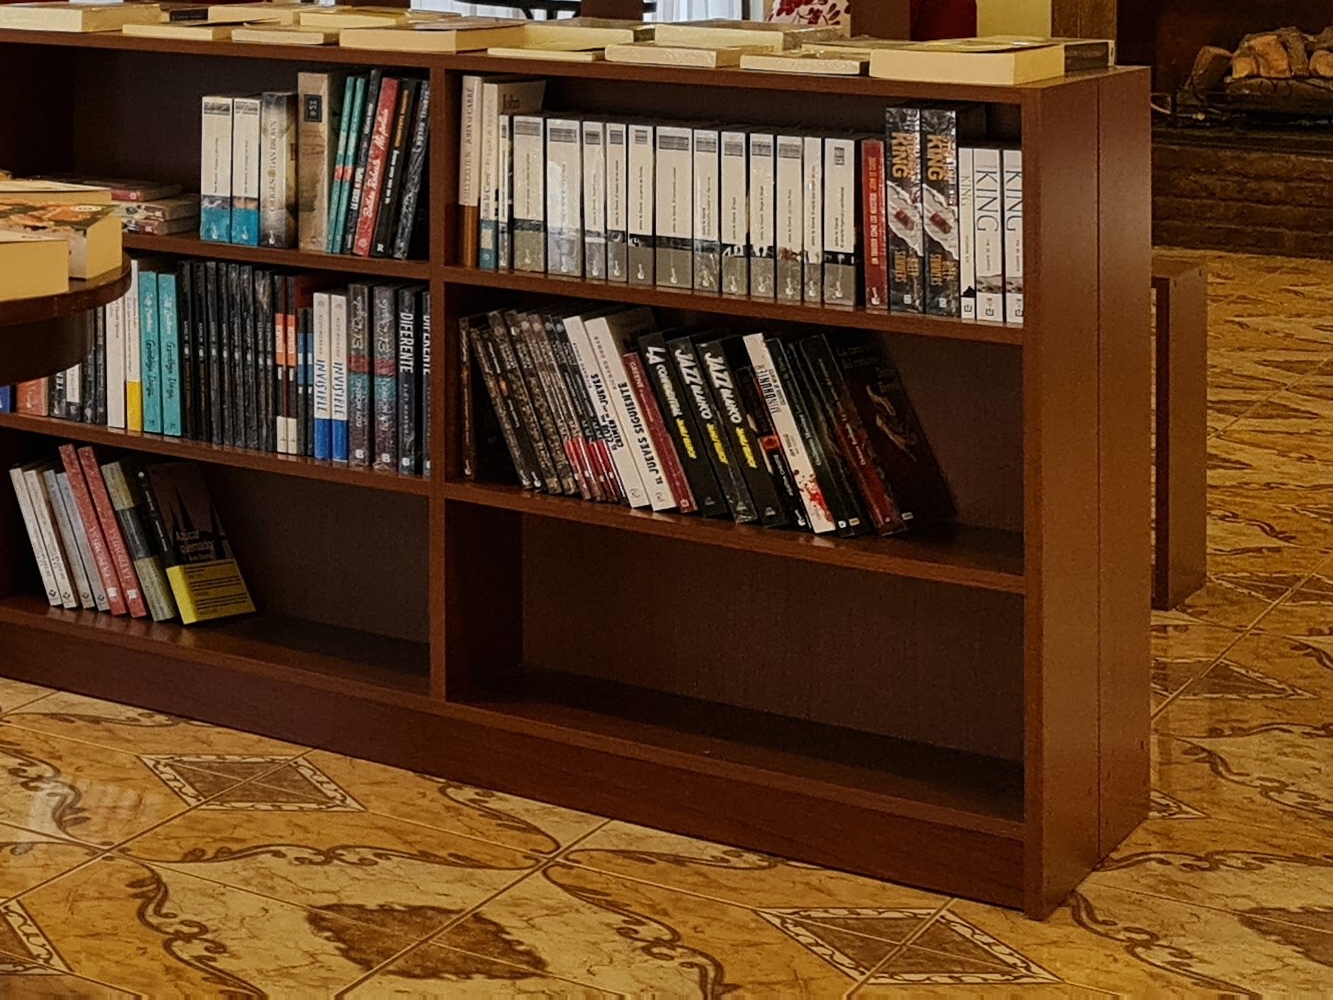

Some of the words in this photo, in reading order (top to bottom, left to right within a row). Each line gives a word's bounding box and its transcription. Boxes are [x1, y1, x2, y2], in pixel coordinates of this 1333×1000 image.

[892, 132, 910, 178] KING
[927, 135, 945, 180] KING
[268, 178, 277, 212] ORIGEN
[961, 175, 972, 206] KING
[975, 170, 999, 232] KING
[1005, 170, 1023, 232] KING
[400, 312, 414, 373] DIFERENTE
[645, 346, 666, 366] LA
[315, 359, 326, 413] INVISIBLE
[332, 362, 344, 415] INVISIBLE
[591, 374, 609, 405] JUEVES
[675, 349, 701, 385] JAZZ
[688, 383, 713, 419] BLANCO
[704, 352, 732, 390] JAZZ
[718, 387, 743, 424] BLANCO
[619, 383, 643, 435] SIGUIENTE
[608, 420, 623, 448] CRIMEN
[639, 437, 659, 475] JUEVES
